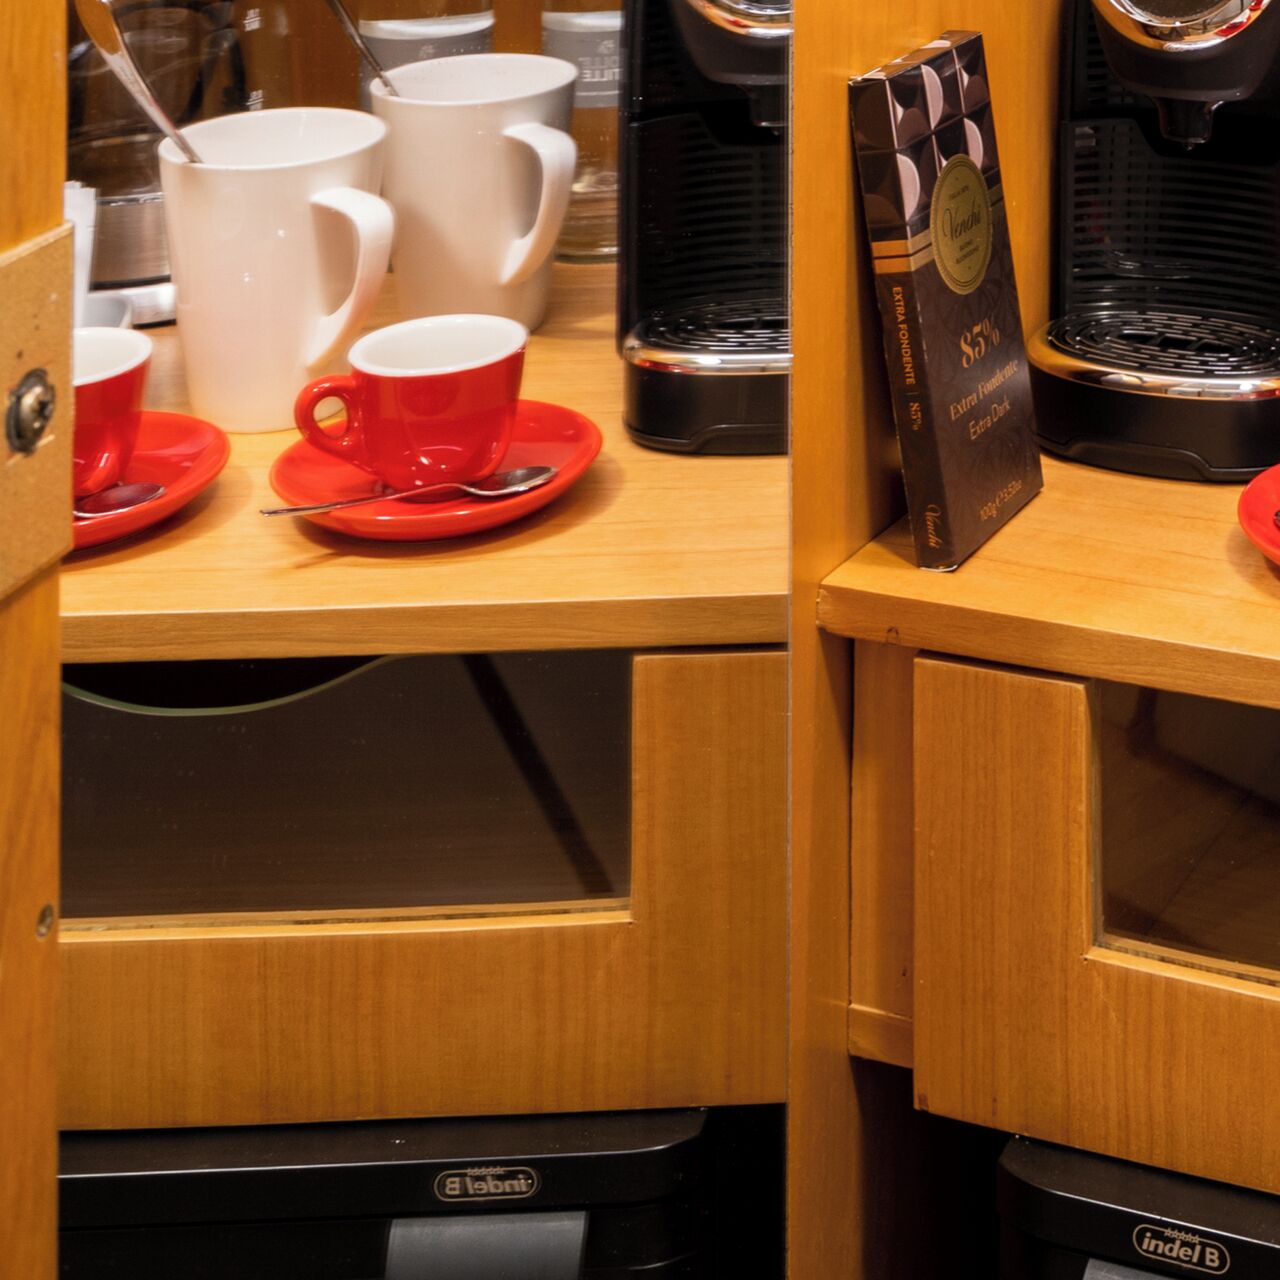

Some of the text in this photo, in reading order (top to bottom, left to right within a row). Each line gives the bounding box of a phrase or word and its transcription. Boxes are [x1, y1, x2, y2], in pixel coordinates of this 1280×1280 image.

[892, 286, 906, 322] EXTRA
[898, 324, 916, 386] FONDENTE
[960, 313, 1000, 369] 85%
[949, 359, 1019, 421] Extra Fondente
[968, 394, 1011, 440] Extra Dark
[1141, 1231, 1220, 1268] indel B
